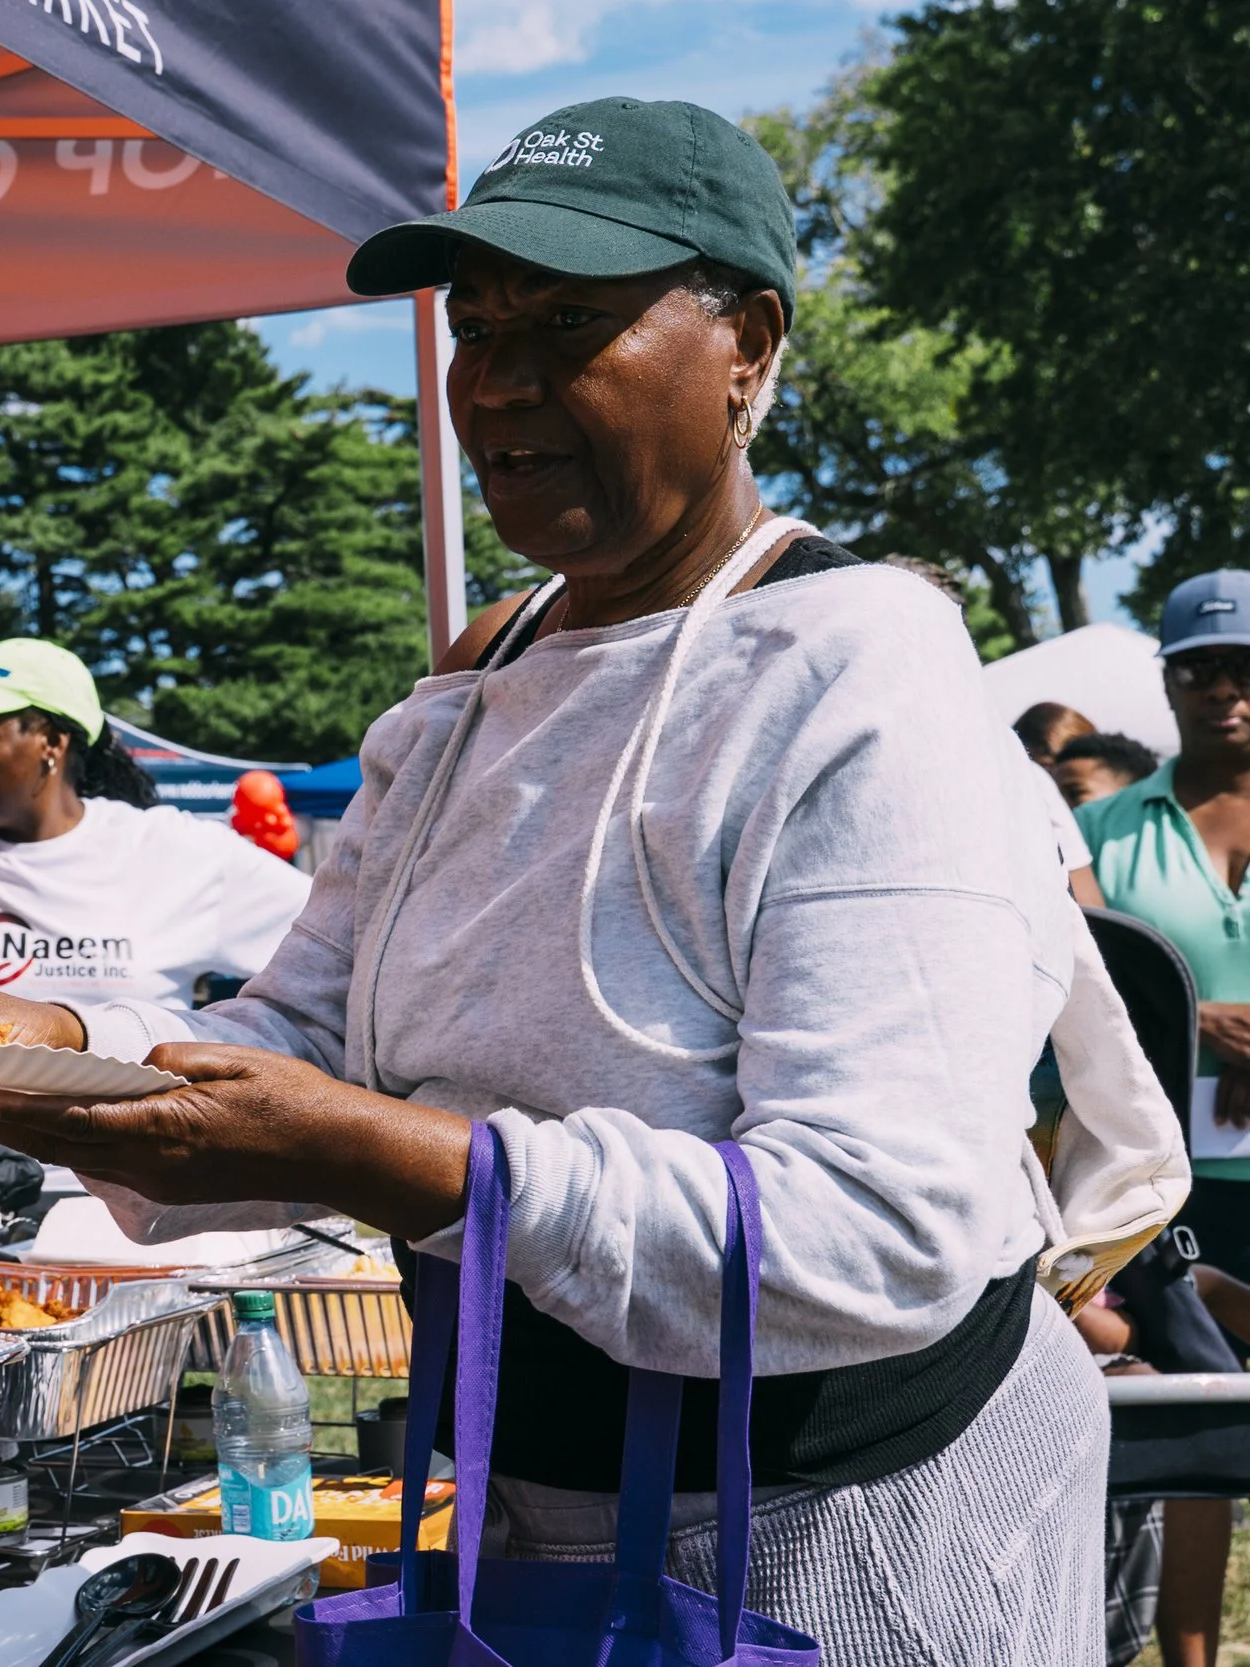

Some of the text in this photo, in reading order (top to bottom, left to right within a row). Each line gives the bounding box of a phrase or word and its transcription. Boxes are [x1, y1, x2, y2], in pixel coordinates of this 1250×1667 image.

[524, 129, 571, 148] Oak
[513, 147, 593, 167] Health
[2, 932, 133, 961] Naeem
[34, 963, 98, 978] Justice
